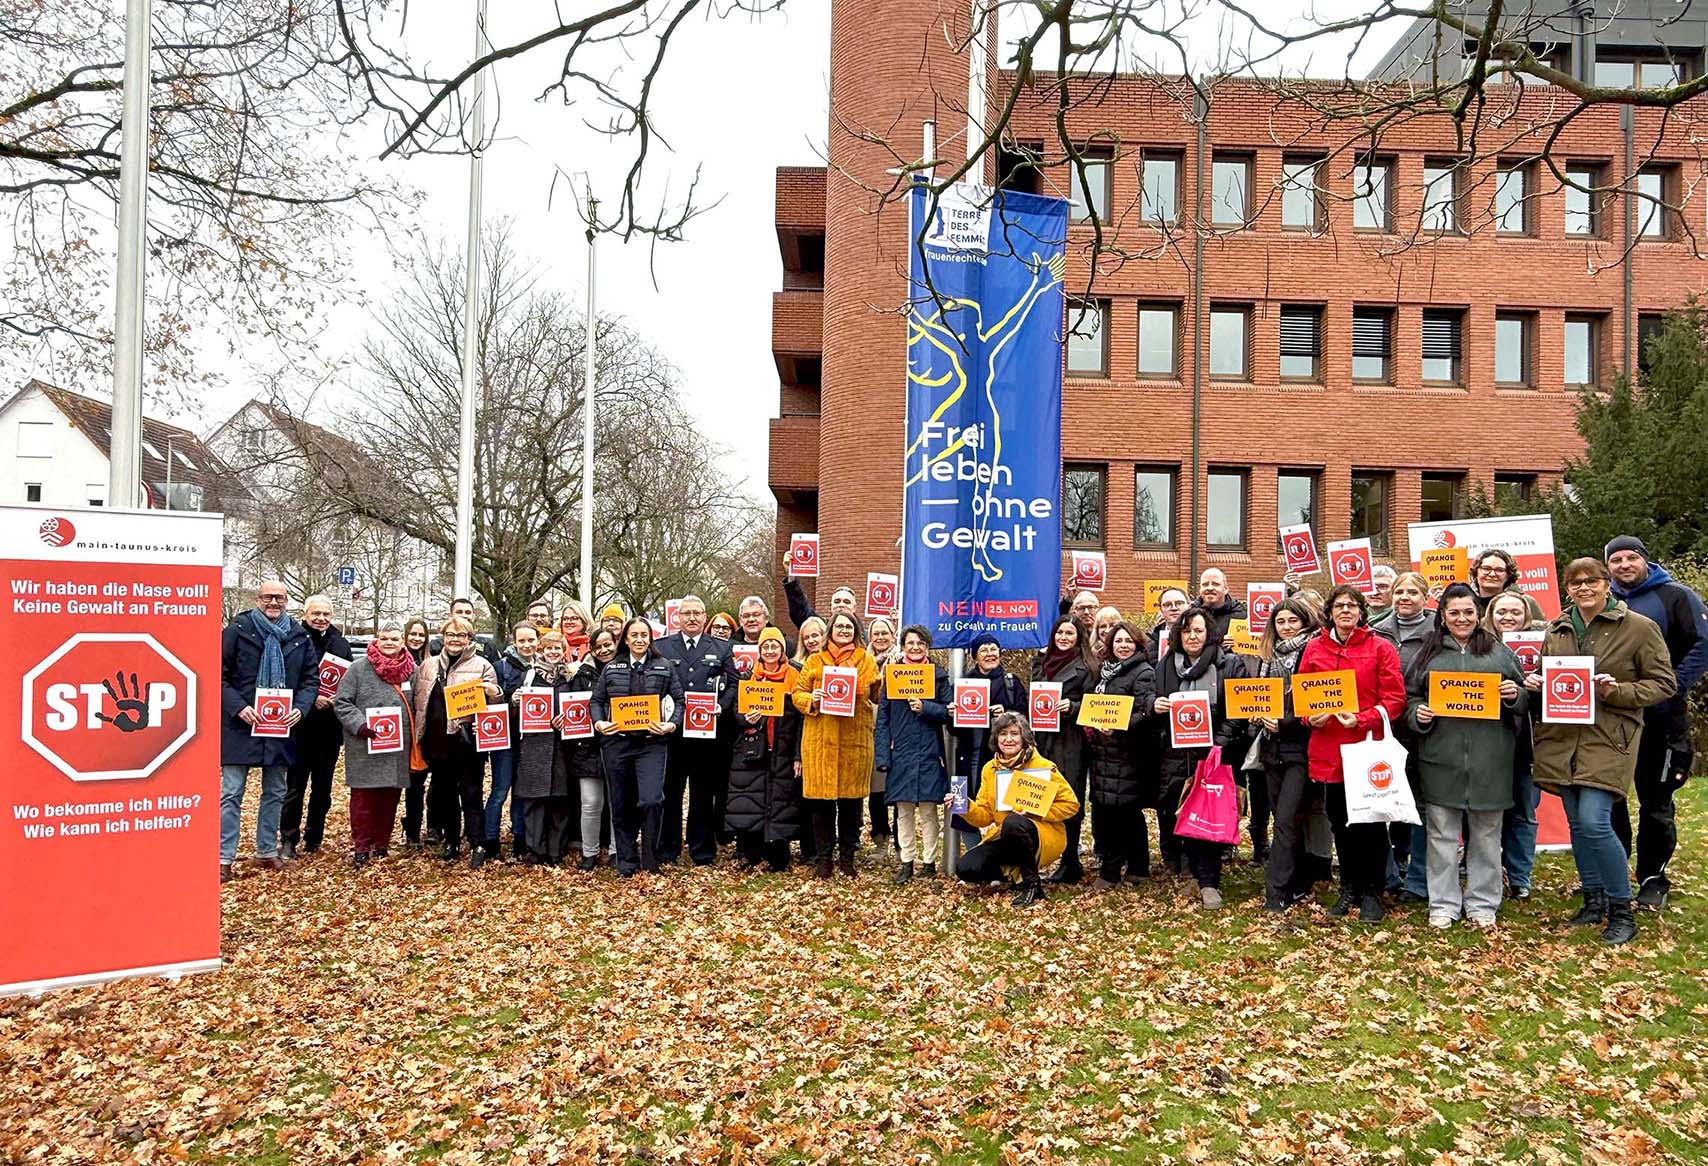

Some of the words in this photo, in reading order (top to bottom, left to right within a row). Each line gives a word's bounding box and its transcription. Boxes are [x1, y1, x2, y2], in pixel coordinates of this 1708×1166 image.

[951, 221, 969, 231] DES
[922, 422, 985, 449] Frei
[922, 453, 1012, 486] leben
[972, 489, 1052, 519] ohne
[921, 522, 1037, 551] Gewalt
[1525, 567, 1548, 578] voll!
[11, 580, 41, 594] Wir
[46, 581, 98, 596] haben
[103, 582, 128, 596] die
[133, 583, 172, 597] Nase
[176, 585, 209, 598] voll!
[1520, 581, 1548, 591] rauen
[13, 599, 61, 613] Keine
[67, 600, 124, 615] Gewalt
[129, 605, 149, 615] an
[154, 601, 207, 615] Frauen
[989, 605, 1006, 614] 25.
[1009, 605, 1033, 613] NOV
[938, 623, 951, 631] zu
[1000, 621, 1037, 631] Frauen
[893, 670, 923, 678] ORANGE
[1301, 678, 1342, 691] ORANGE
[1439, 679, 1484, 689] ORANGE
[1233, 685, 1270, 695] ORANGE
[1323, 689, 1342, 697] THE
[1463, 692, 1484, 700] THE
[45, 682, 177, 731] STOP
[618, 701, 649, 710] ORANGE
[1089, 700, 1121, 708] ORANGE
[1309, 700, 1343, 710] WORLD
[1446, 703, 1484, 712] WORLD
[623, 718, 649, 726] WORLD
[1018, 778, 1047, 791] ORANGE
[1029, 791, 1042, 800] THE
[14, 805, 39, 819] Wo
[44, 800, 124, 816] bekomme
[129, 797, 153, 811] ich
[157, 794, 201, 810] Hilfe?
[1015, 798, 1040, 809] WORLD
[24, 824, 55, 839] Wie
[60, 822, 100, 836] kann
[105, 818, 130, 832] ich
[134, 814, 192, 831] helfen?
